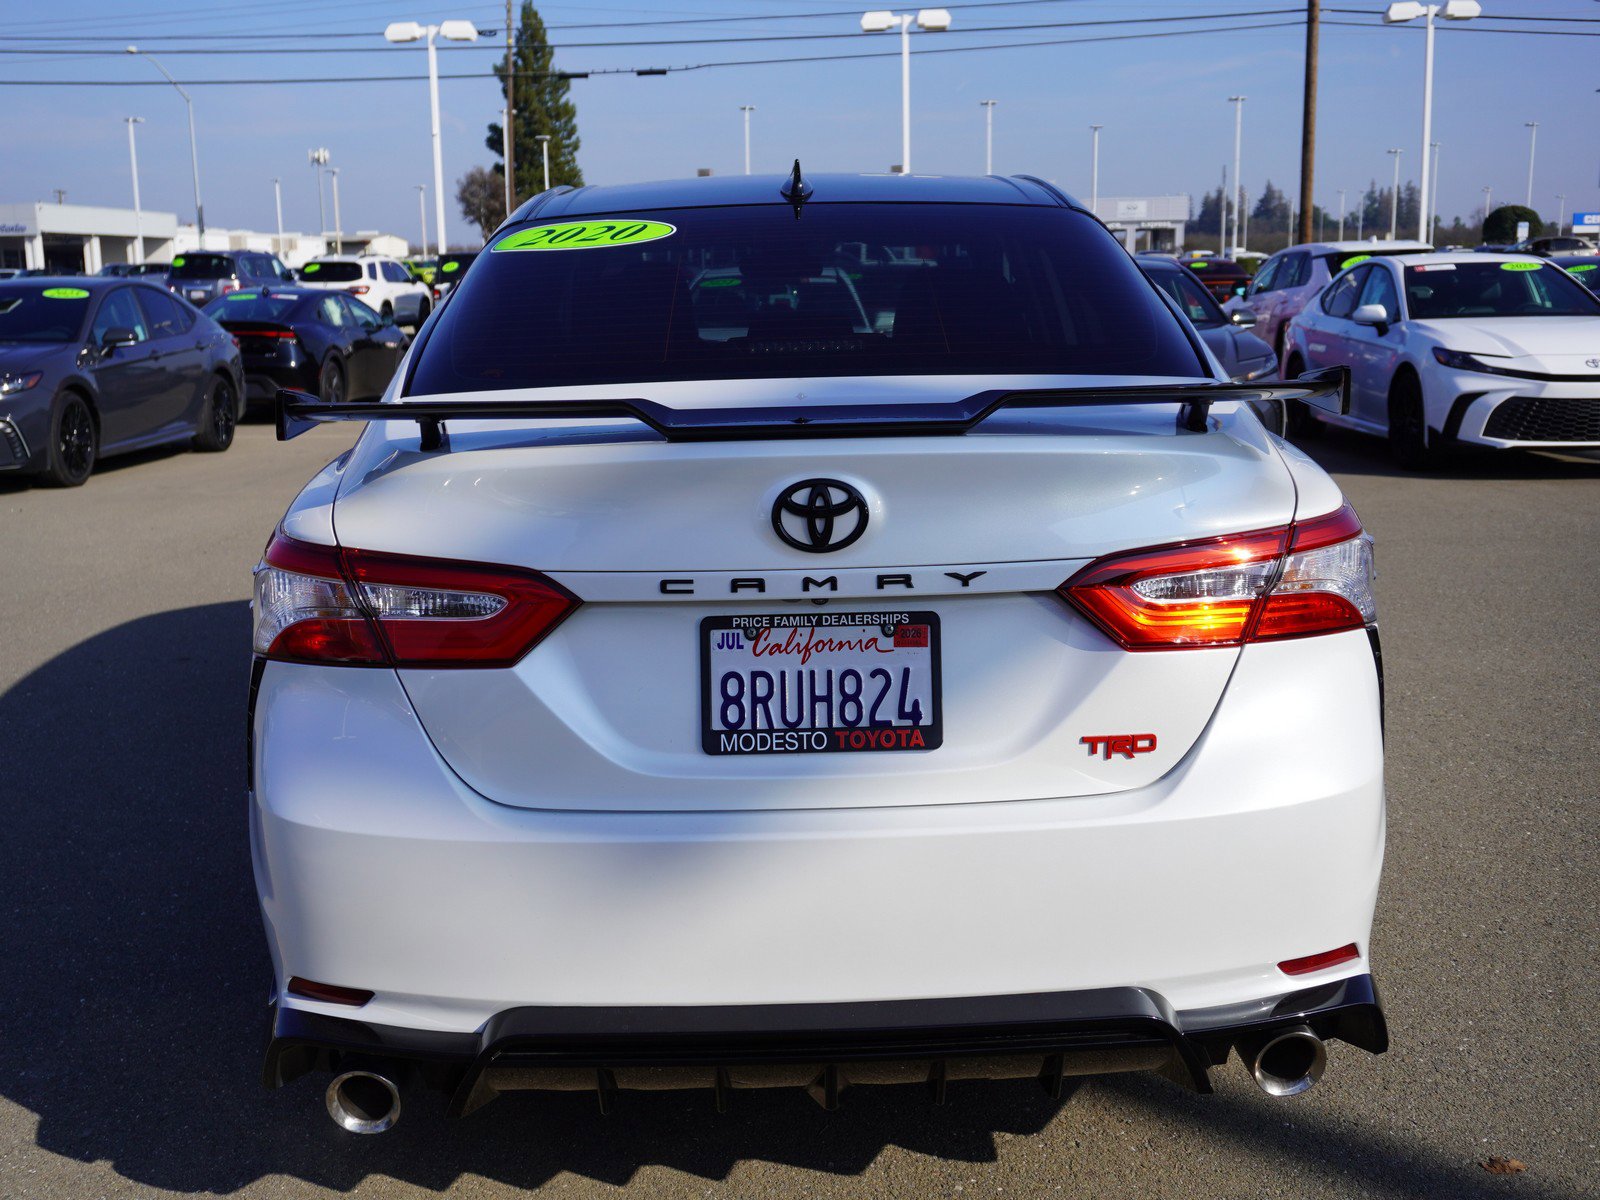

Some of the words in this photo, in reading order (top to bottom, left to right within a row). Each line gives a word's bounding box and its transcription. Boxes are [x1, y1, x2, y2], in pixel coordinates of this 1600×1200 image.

[515, 223, 649, 248] 2020
[659, 570, 987, 595] CAMRY
[732, 617, 770, 628] PRICE
[774, 615, 817, 627] FAMILY
[822, 613, 910, 626] DEALERSHIPS
[716, 632, 744, 650] JUL
[752, 627, 894, 665] California
[720, 667, 923, 730] 8RUH824
[720, 732, 827, 752] MODESTO
[835, 729, 925, 749] TOYOTA
[1080, 733, 1157, 760] TRD
